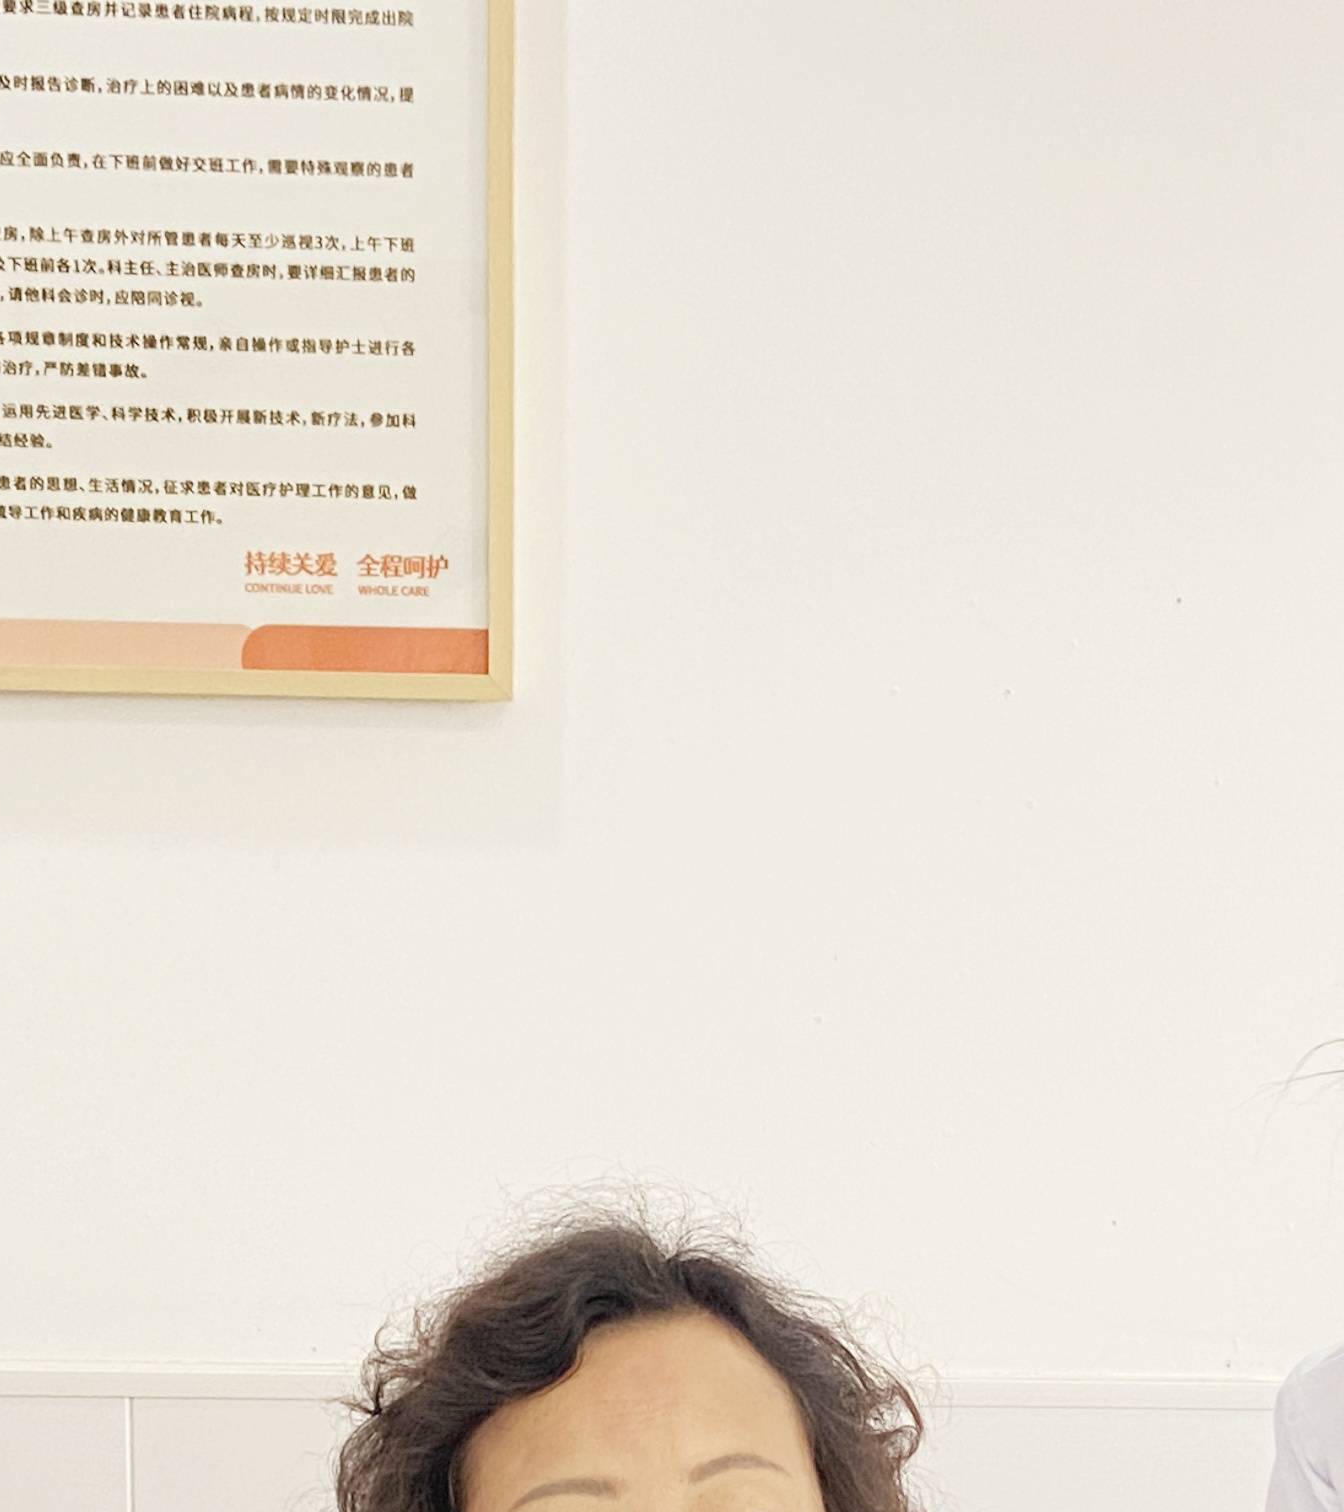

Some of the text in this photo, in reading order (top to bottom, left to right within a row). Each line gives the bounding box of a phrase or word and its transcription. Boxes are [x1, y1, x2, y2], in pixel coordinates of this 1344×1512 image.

[245, 551, 449, 579] 持续关爱 全程呵护
[244, 582, 431, 598] CONTINUE LOVE WHOLE CARE
